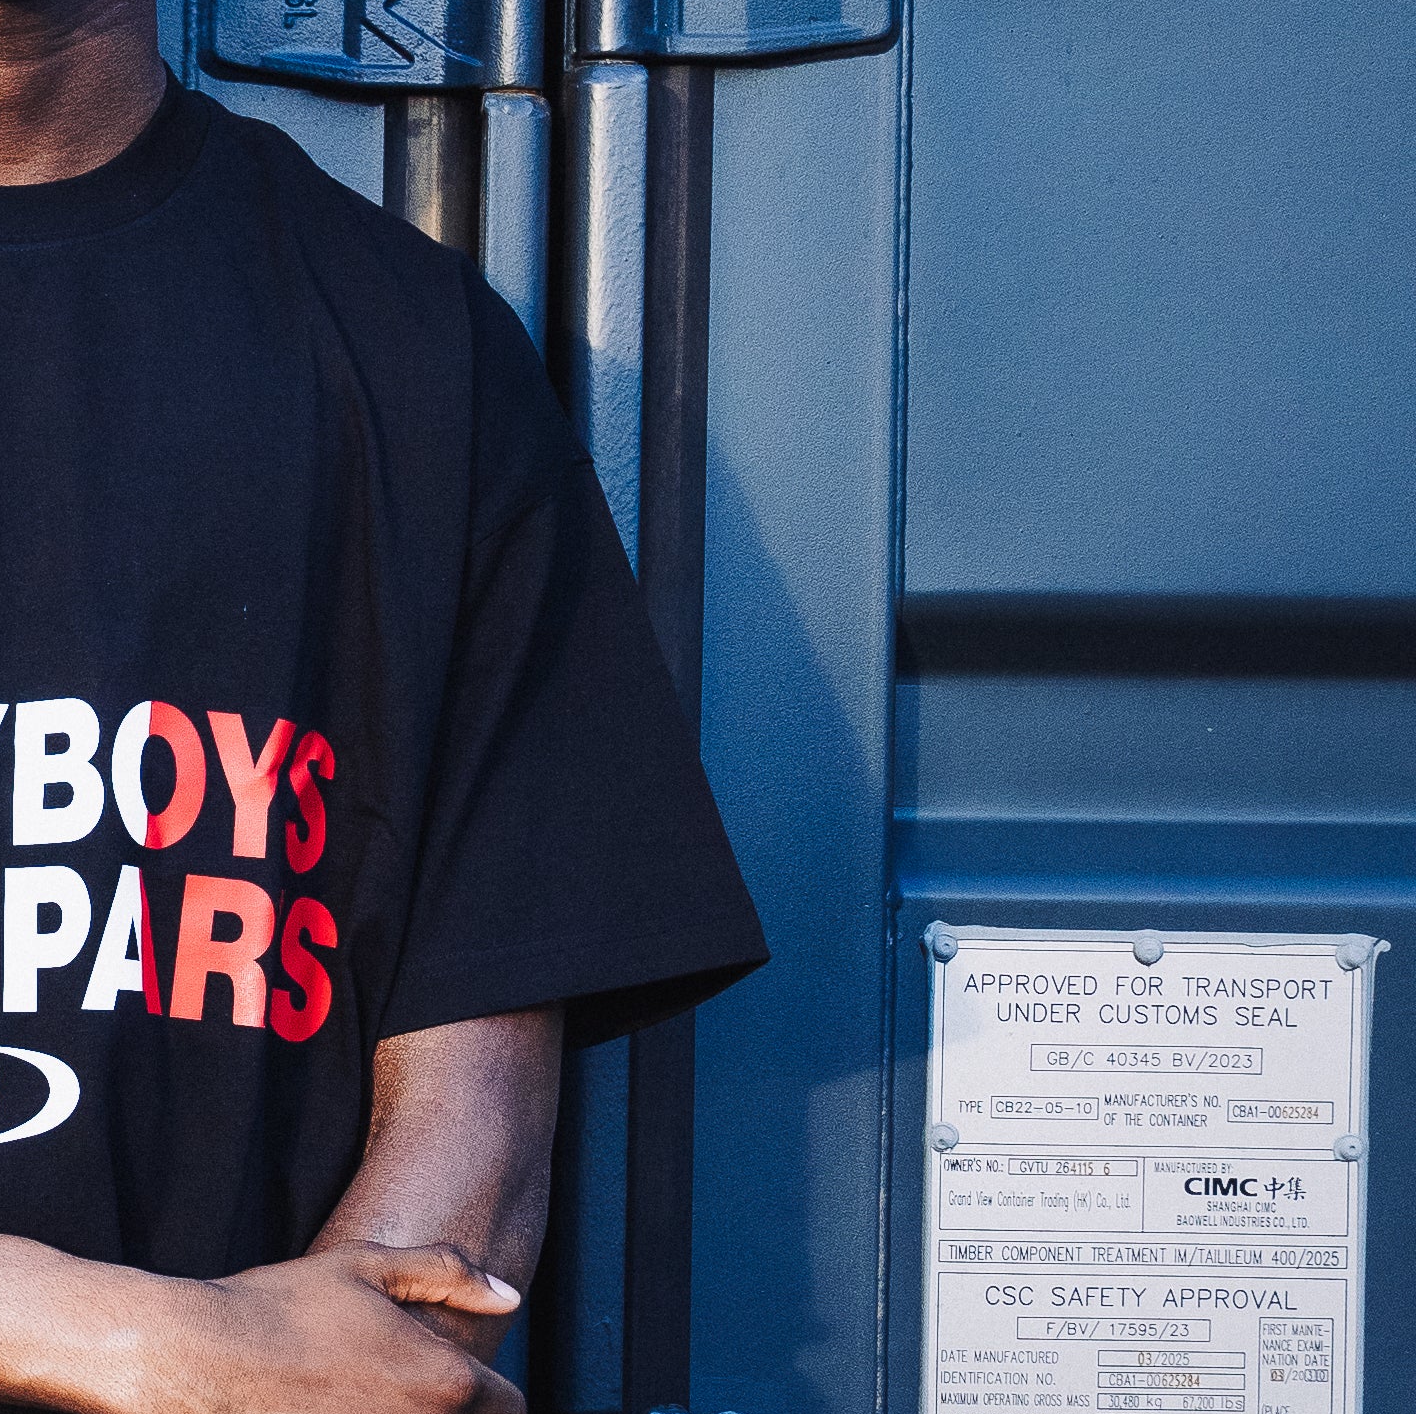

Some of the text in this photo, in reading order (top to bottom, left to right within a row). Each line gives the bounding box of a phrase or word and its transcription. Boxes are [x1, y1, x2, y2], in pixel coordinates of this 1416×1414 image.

[964, 973, 1333, 1000] APPROVED FOR TRANSPORT
[997, 1002, 1298, 1028] UNDER CUSTOMS SEAL
[1047, 1050, 1253, 1071] GB/C 40345 BV/2023
[959, 1100, 1092, 1115] TYPE CB22-05-10
[1104, 1094, 1222, 1108] MANUFACTURER'S NO.
[1104, 1113, 1208, 1128] OF THE CONTAINER
[943, 1158, 982, 1173] OWNER'S
[1019, 1161, 1048, 1174] GVTU
[1154, 1162, 1217, 1174] MANUFACTURED
[1185, 1177, 1258, 1197] CIMC
[1263, 1177, 1307, 1201] 中集
[948, 1190, 971, 1206] Grand
[976, 1190, 992, 1206] View
[997, 1191, 1035, 1207] Container
[1040, 1191, 1069, 1212] Trading
[1206, 1201, 1277, 1213] SHANGHAI CIMC
[1220, 1216, 1271, 1228] INDUSTRIES
[948, 1244, 993, 1261] TIMBER
[1002, 1245, 1083, 1262] COMPONENT
[1091, 1247, 1167, 1263] TREATMENT
[1272, 1249, 1339, 1269] 400/2025
[985, 1286, 1298, 1311] CSC SAFETY APPROVAL
[1110, 1322, 1190, 1340] 17595/23
[1262, 1323, 1287, 1336] FIRST
[1262, 1339, 1292, 1352] NANCE
[940, 1349, 968, 1363] DATE
[974, 1351, 1059, 1365] MANUFACTURED
[1262, 1354, 1329, 1367] NATION DATE
[940, 1371, 1029, 1385] IDENTIFICATION
[1036, 1373, 1056, 1386] NO.
[941, 1392, 978, 1405] MAXIMUM
[983, 1393, 1029, 1406] OPERATING
[1034, 1394, 1062, 1407] GROSS
[1066, 1395, 1090, 1407] MASS
[1146, 1396, 1162, 1409] kg
[1220, 1397, 1243, 1410] lbs
